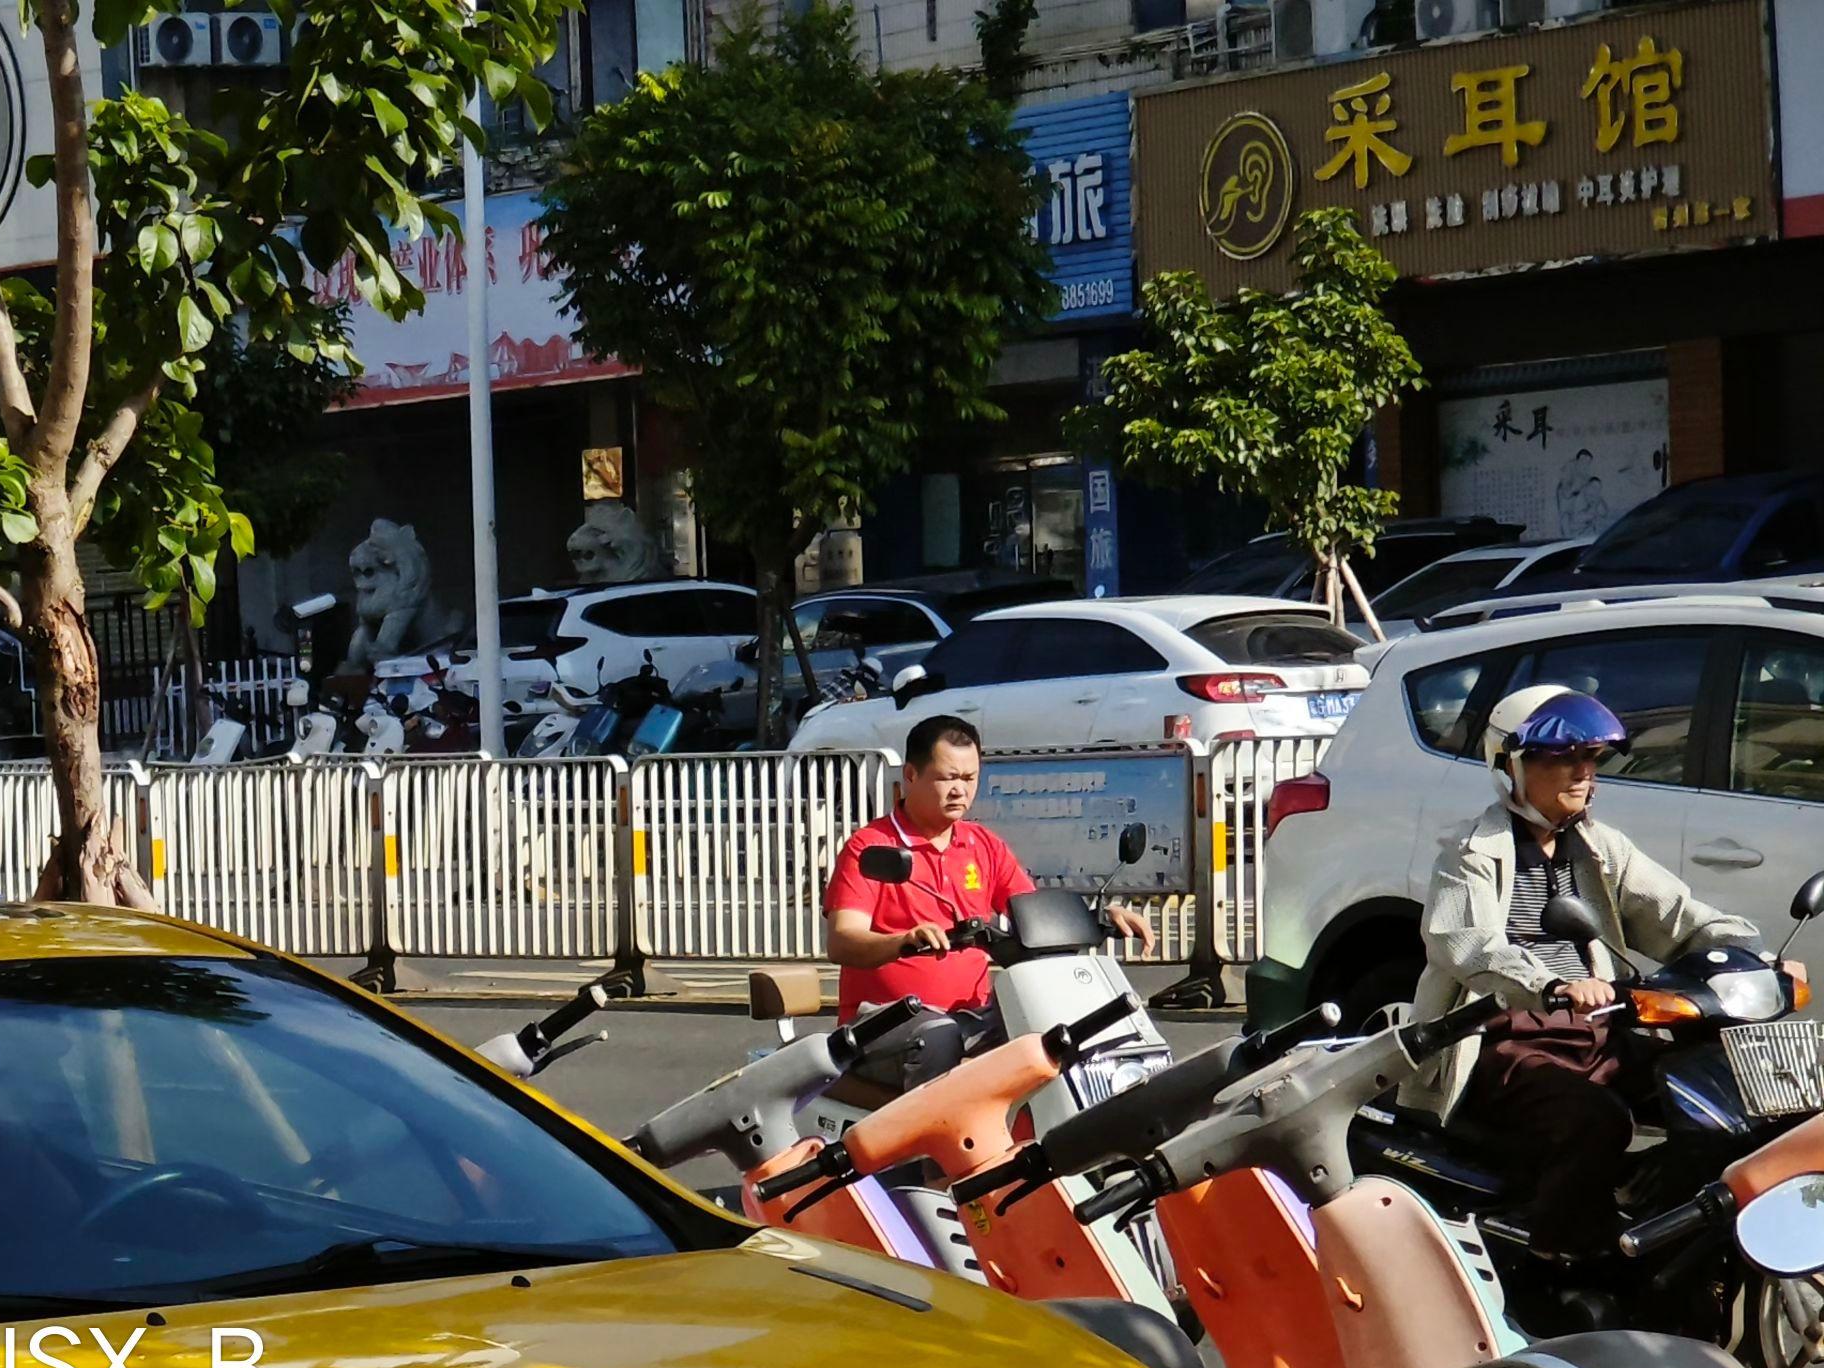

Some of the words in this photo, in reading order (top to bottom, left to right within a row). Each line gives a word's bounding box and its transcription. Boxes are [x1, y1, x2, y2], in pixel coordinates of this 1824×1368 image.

[1313, 35, 1683, 189] 采耳馆
[1493, 399, 1553, 449] 采耳
